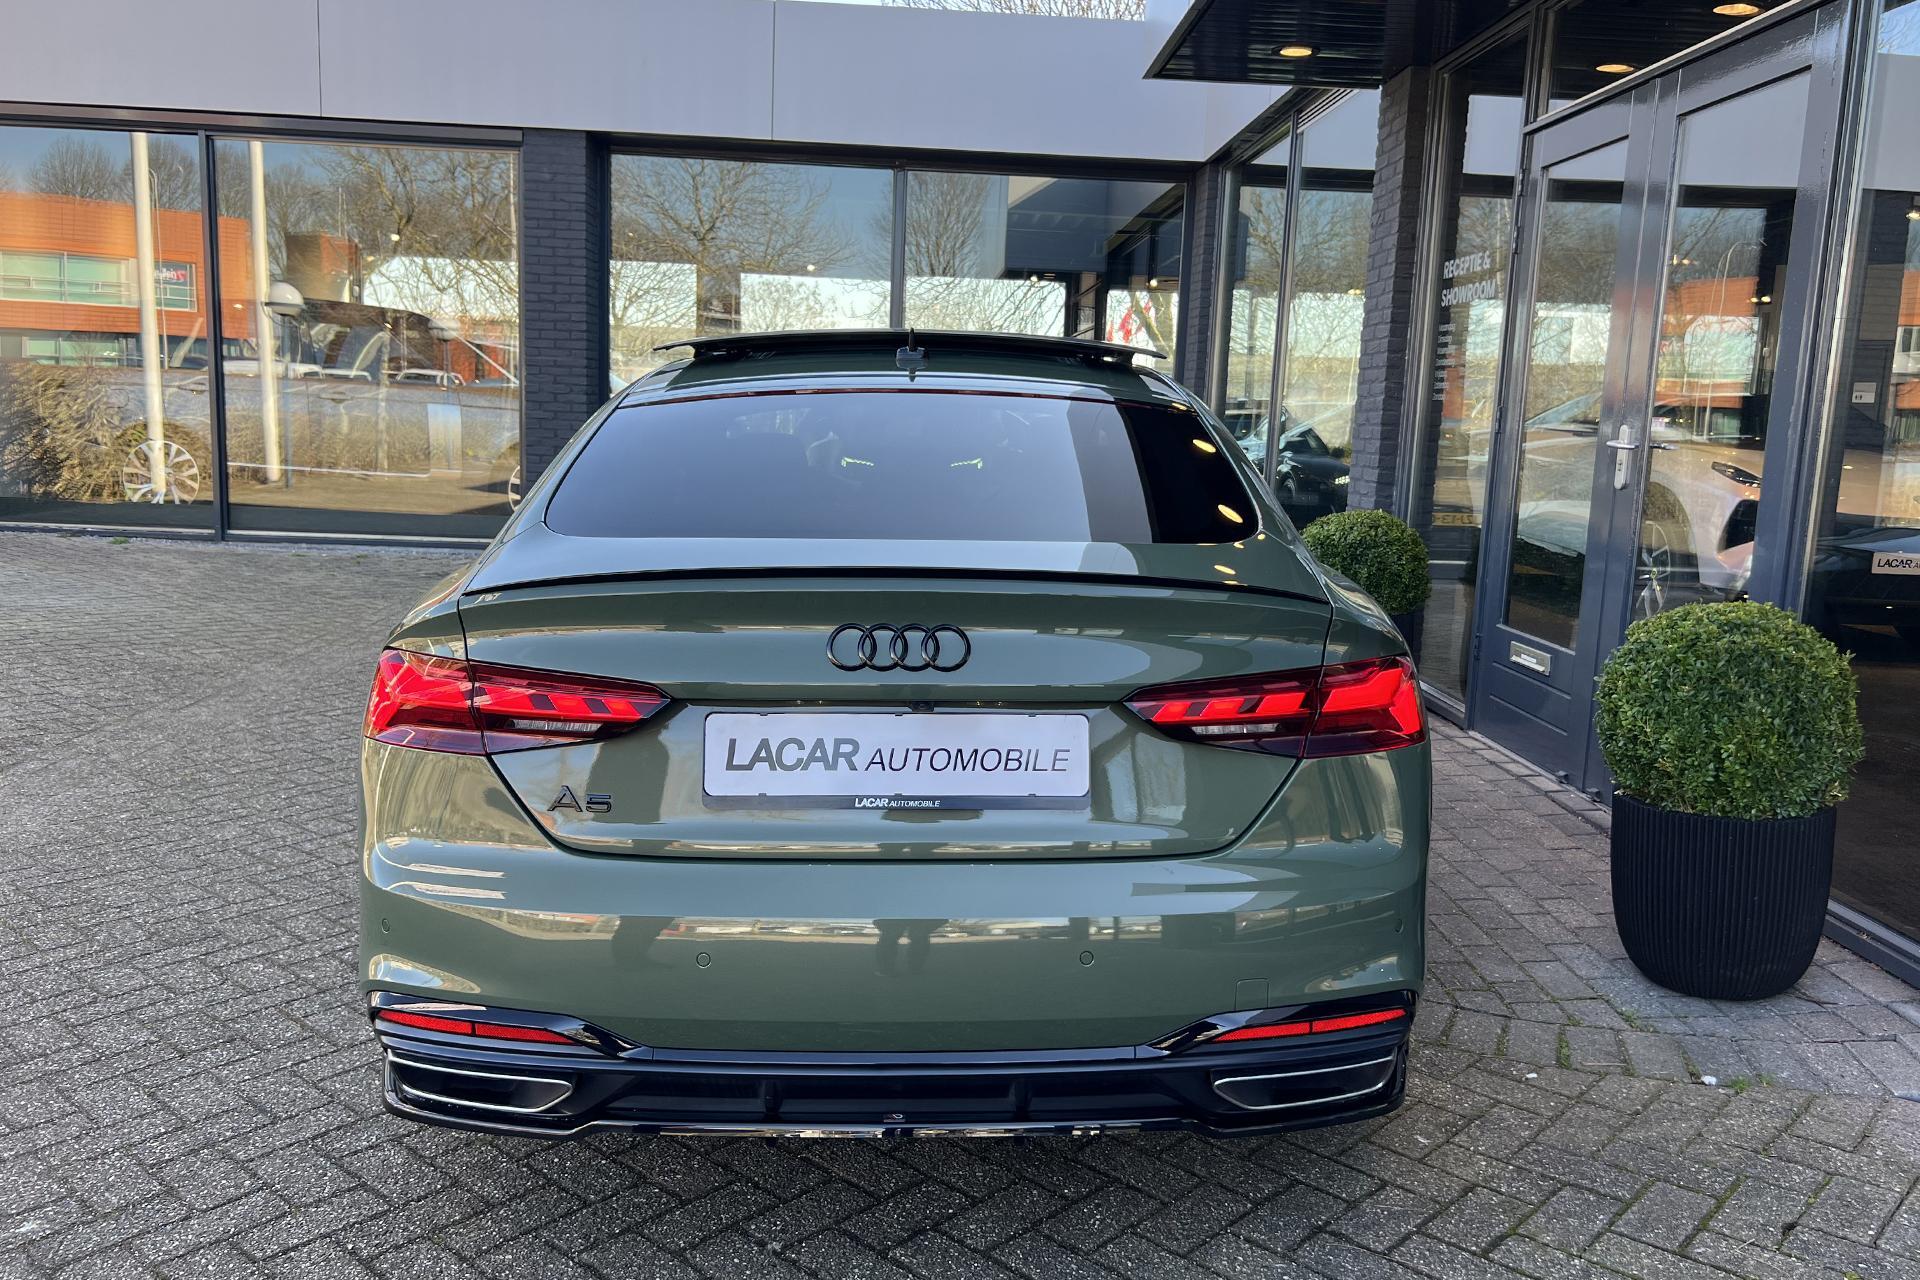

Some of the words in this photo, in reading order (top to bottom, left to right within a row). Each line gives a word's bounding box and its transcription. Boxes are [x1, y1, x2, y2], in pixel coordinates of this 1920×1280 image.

[1443, 252, 1483, 279] RECEPTIE
[1483, 250, 1491, 269] &
[1441, 279, 1496, 307] SHOWROOM
[1877, 558, 1912, 568] LACAR
[725, 737, 859, 771] LACAR
[865, 748, 1071, 771] AUTOMOBILE
[547, 785, 612, 813] A5
[855, 798, 889, 807] LACAR
